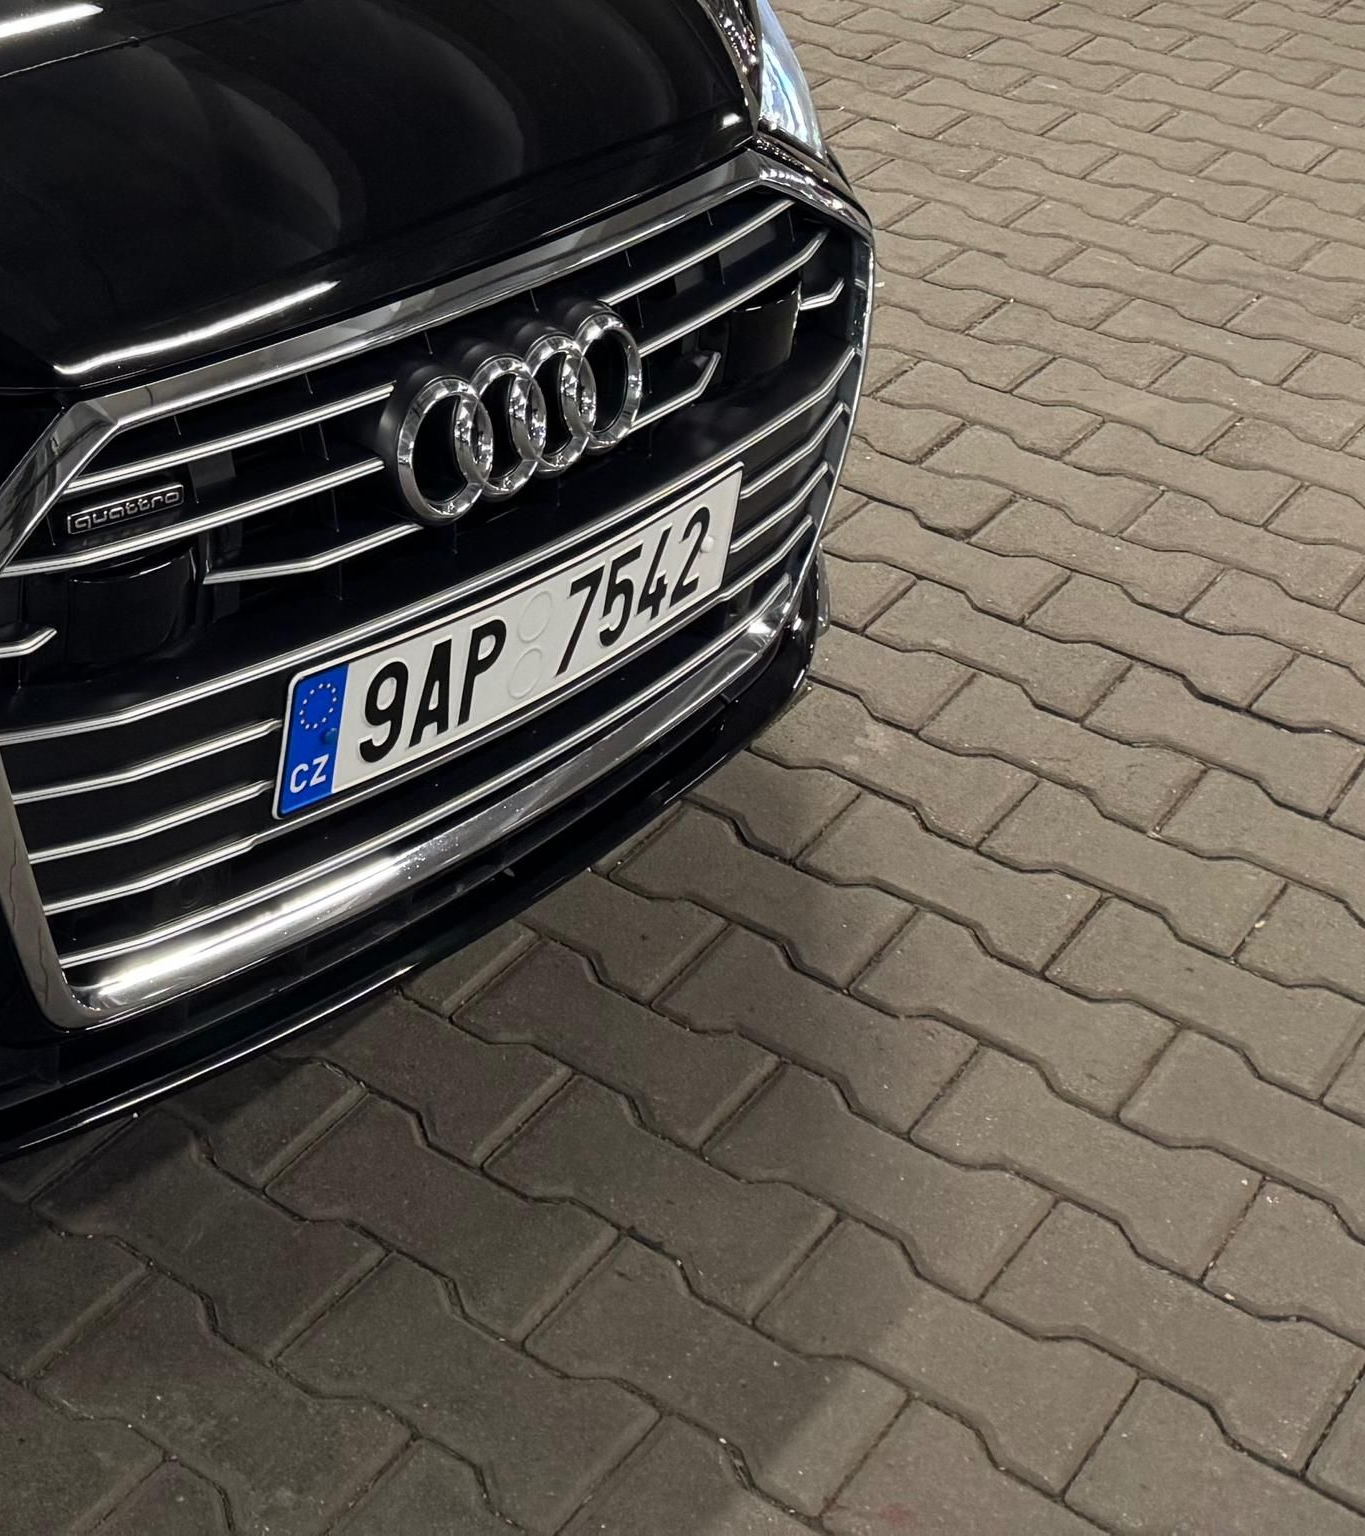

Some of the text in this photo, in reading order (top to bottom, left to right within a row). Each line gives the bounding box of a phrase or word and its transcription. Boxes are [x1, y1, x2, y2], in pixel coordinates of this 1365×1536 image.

[74, 490, 180, 530] quattro
[358, 506, 711, 764] 9AP 7542
[288, 754, 330, 795] CZ
